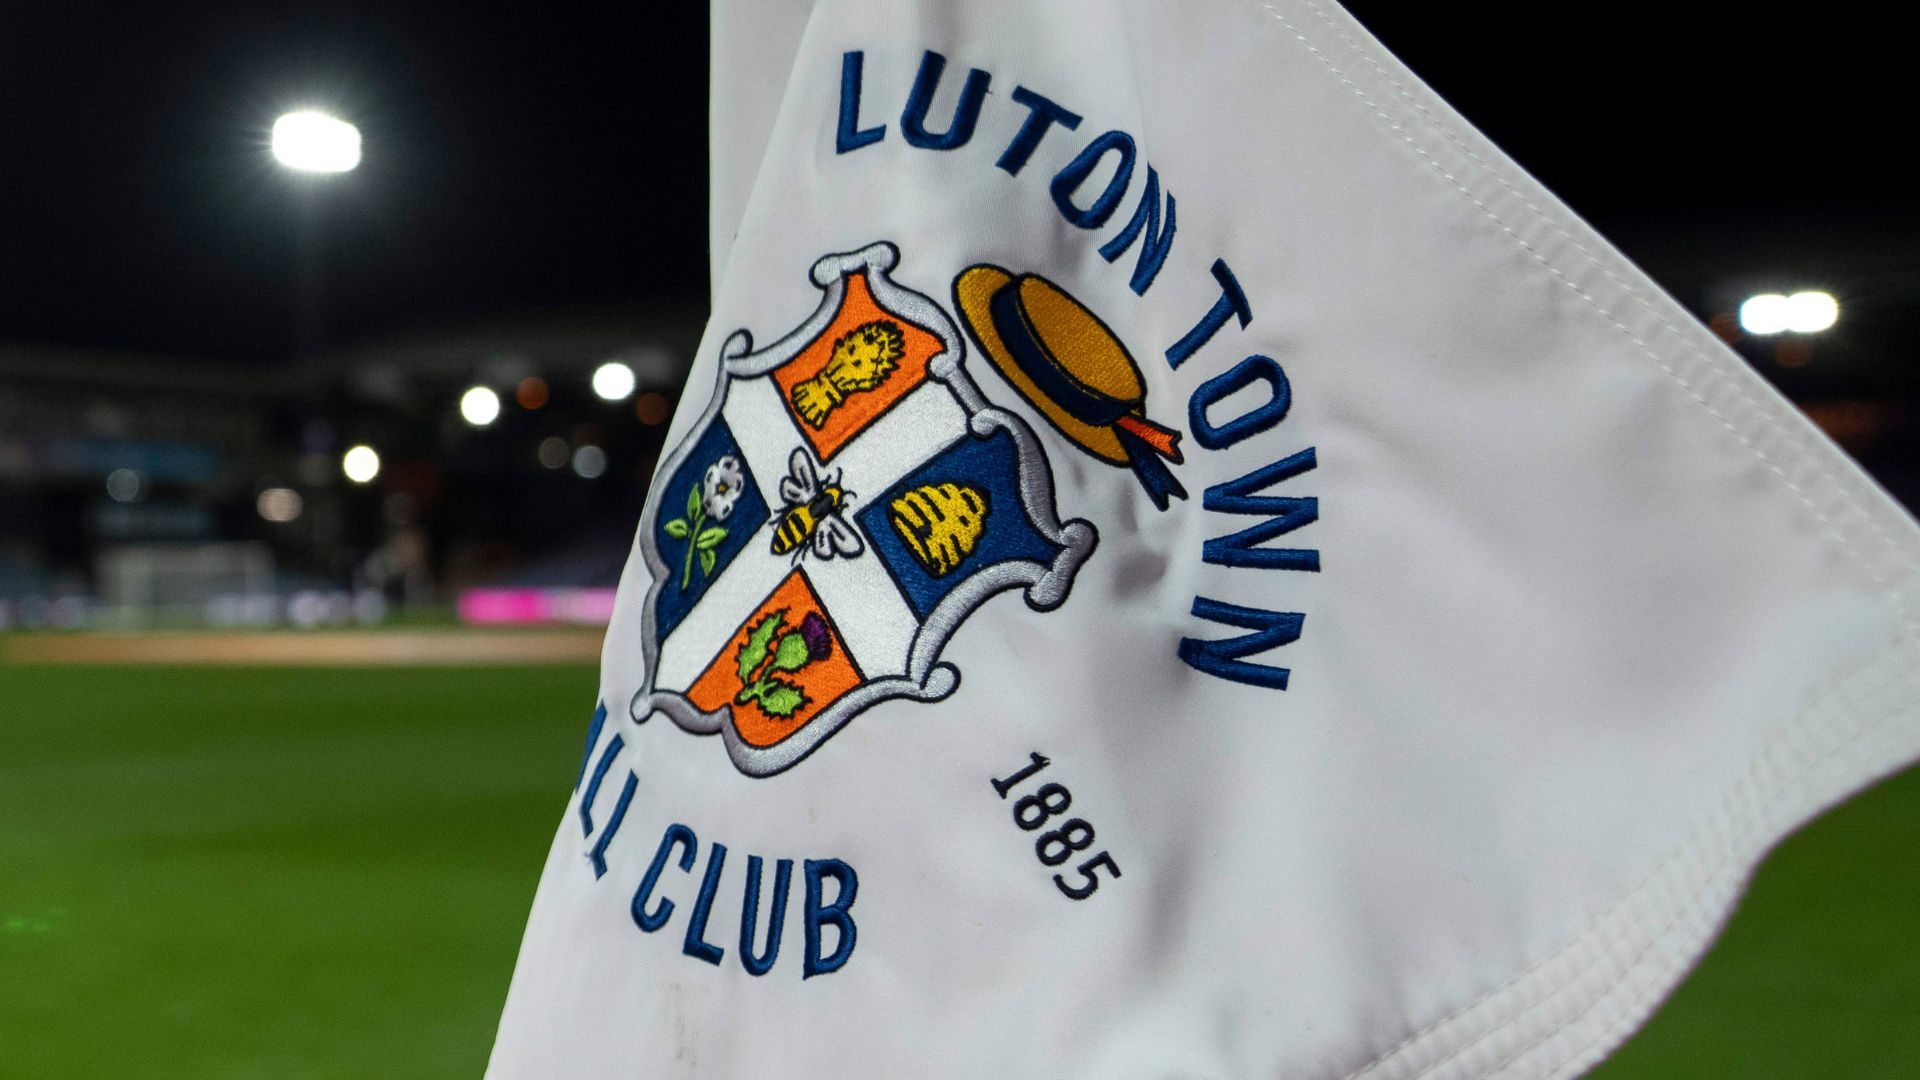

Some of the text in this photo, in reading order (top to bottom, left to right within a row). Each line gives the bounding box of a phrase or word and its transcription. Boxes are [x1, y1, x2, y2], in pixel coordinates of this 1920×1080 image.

[835, 49, 1322, 692] LUTON TOWN
[630, 823, 860, 981] CLUB
[990, 751, 1122, 901] 1885
